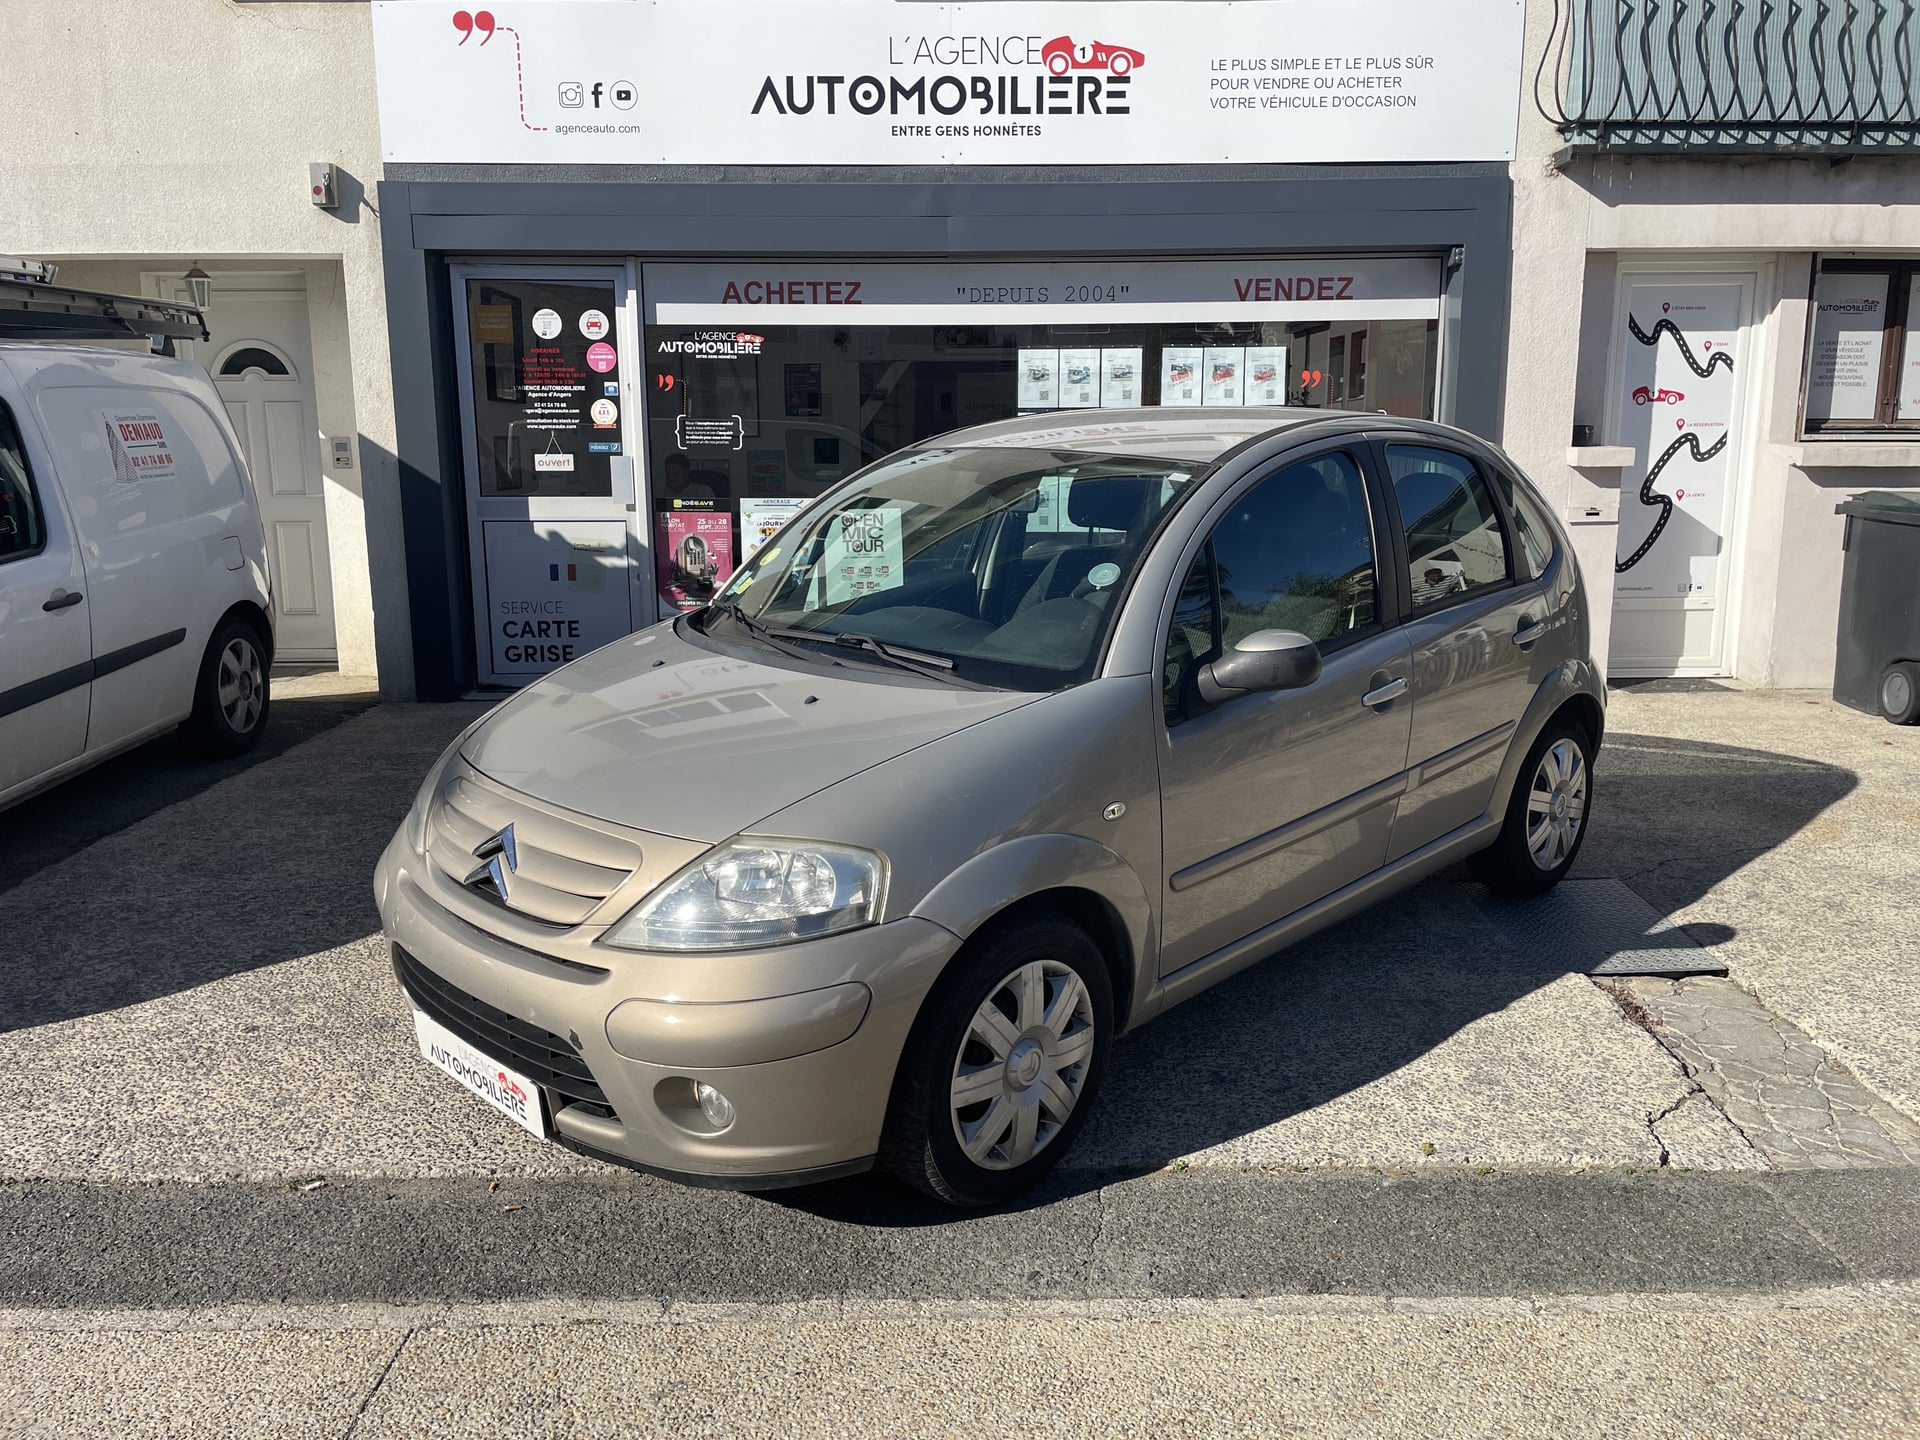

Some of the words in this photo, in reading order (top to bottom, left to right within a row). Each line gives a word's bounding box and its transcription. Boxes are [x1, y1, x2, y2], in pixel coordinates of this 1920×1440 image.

[888, 35, 1042, 65] L'AGENCE
[1211, 59, 1227, 71] LE
[1231, 59, 1267, 71] PLUS
[1270, 58, 1320, 70] SIMPLE
[1324, 58, 1342, 70] ET
[1345, 58, 1362, 70] LE
[1366, 58, 1401, 70] PLUS
[1405, 54, 1434, 69] SÛR
[1210, 78, 1250, 90] POUR
[1253, 78, 1310, 90] VENDRE
[1313, 78, 1334, 89] OU
[1337, 76, 1402, 88] ACHETER
[1210, 97, 1256, 109] VOTRE
[1260, 94, 1328, 108] VÉHICULE
[1332, 96, 1417, 108] D'OCCASION
[555, 123, 641, 136] agenceauto.com
[891, 125, 932, 137] ENTRE
[935, 125, 970, 137] GENS
[973, 121, 1042, 137] HONNÊTES
[721, 281, 863, 304] ACHETEZ
[1233, 277, 1354, 301] VENDEZ
[694, 332, 737, 340] L'AGENCE
[658, 341, 761, 354] AUTOMOBILIERE
[118, 422, 163, 442] DENIAUD
[538, 459, 570, 467] ouvert
[842, 513, 884, 527] OPEN
[842, 527, 884, 539] MIC
[842, 540, 884, 552] TOUR
[501, 600, 564, 614] SERVICE
[502, 620, 580, 638] CARTE
[504, 644, 575, 663] GRISE
